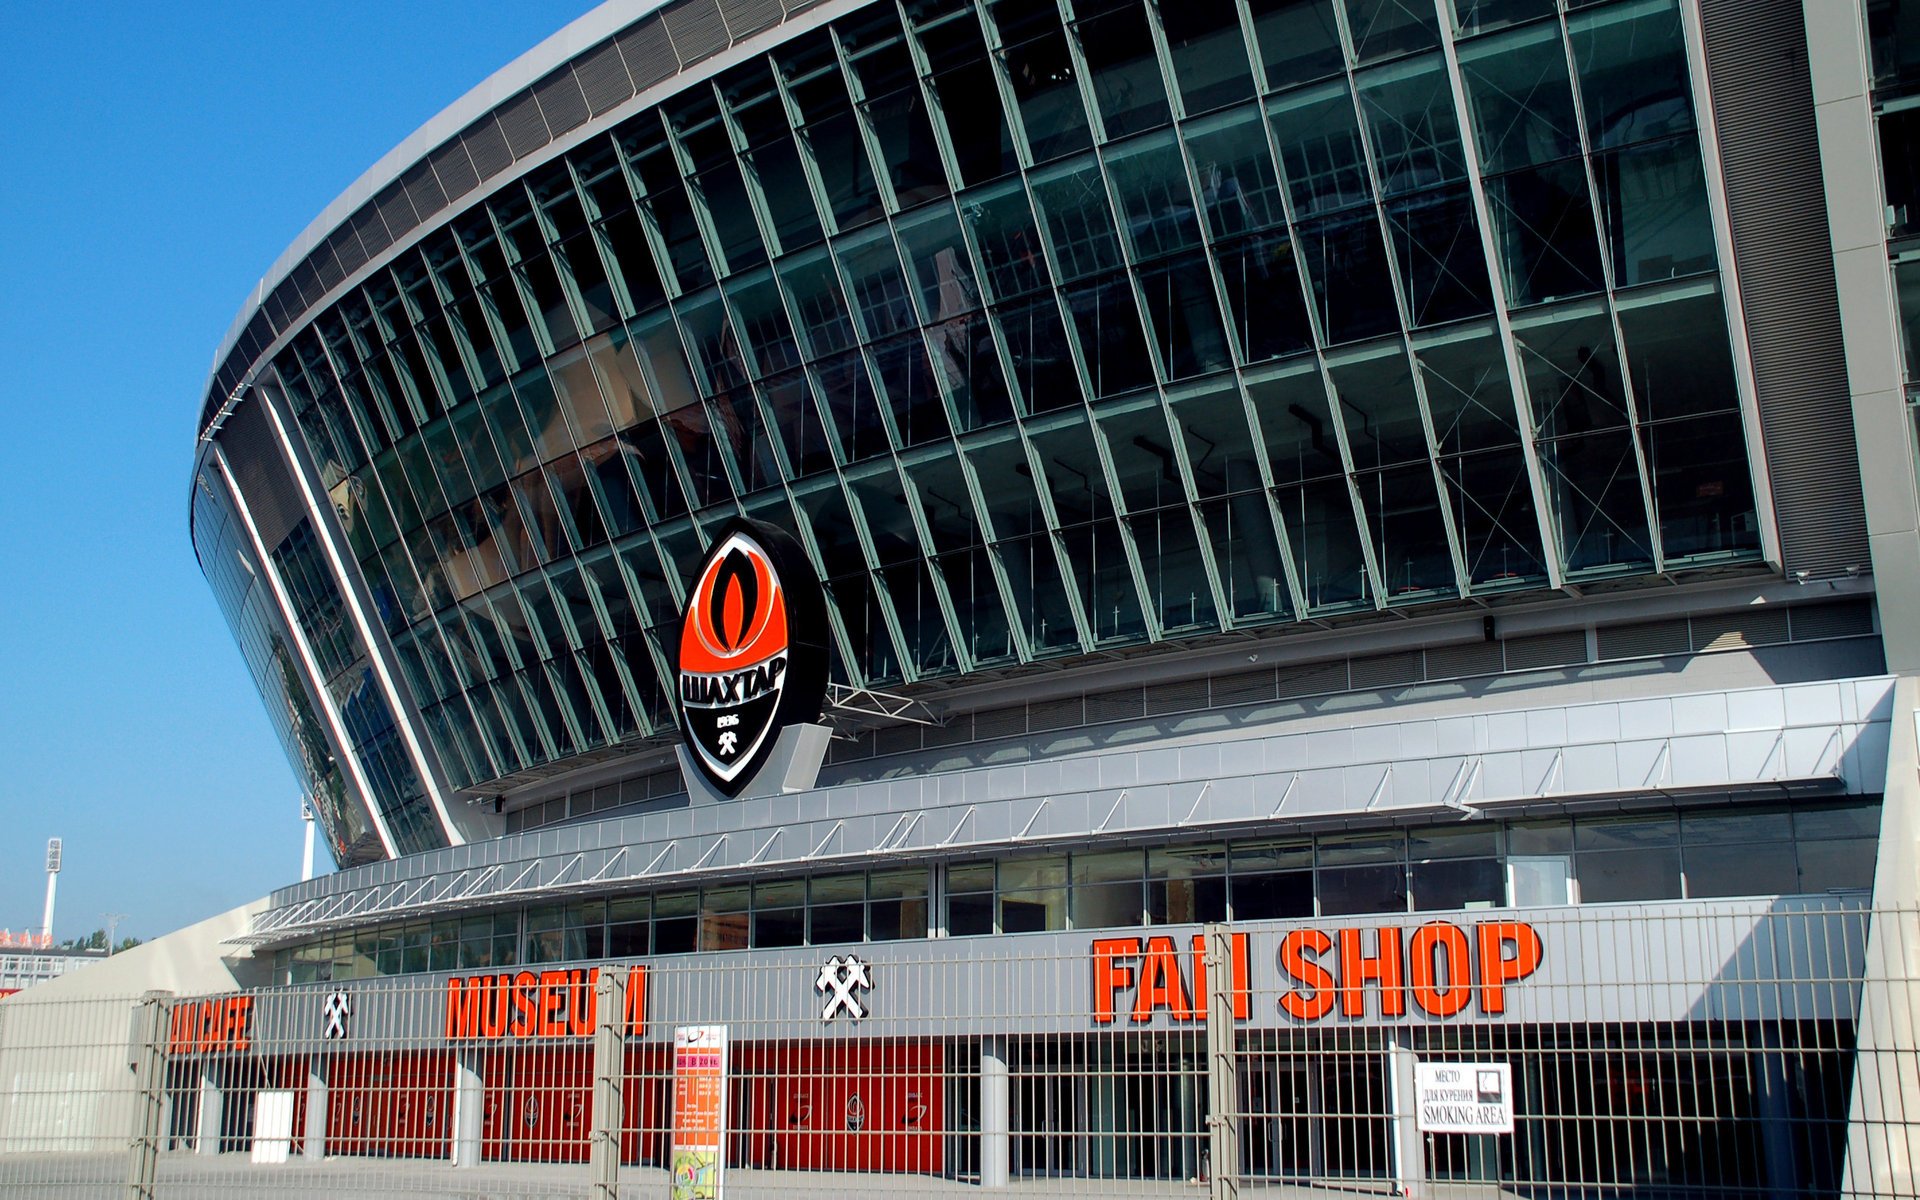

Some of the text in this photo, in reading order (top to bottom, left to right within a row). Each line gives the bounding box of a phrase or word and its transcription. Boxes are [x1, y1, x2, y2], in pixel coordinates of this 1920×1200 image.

[683, 657, 786, 704] ШАХТАР
[1279, 920, 1543, 1019] SHOP
[198, 996, 252, 1053] CAFE
[1435, 1070, 1461, 1082] МЕСТО
[1423, 1089, 1474, 1103] ДЛЯ КУРЕНИЯ
[1424, 1106, 1505, 1125] SMOKING AREA
